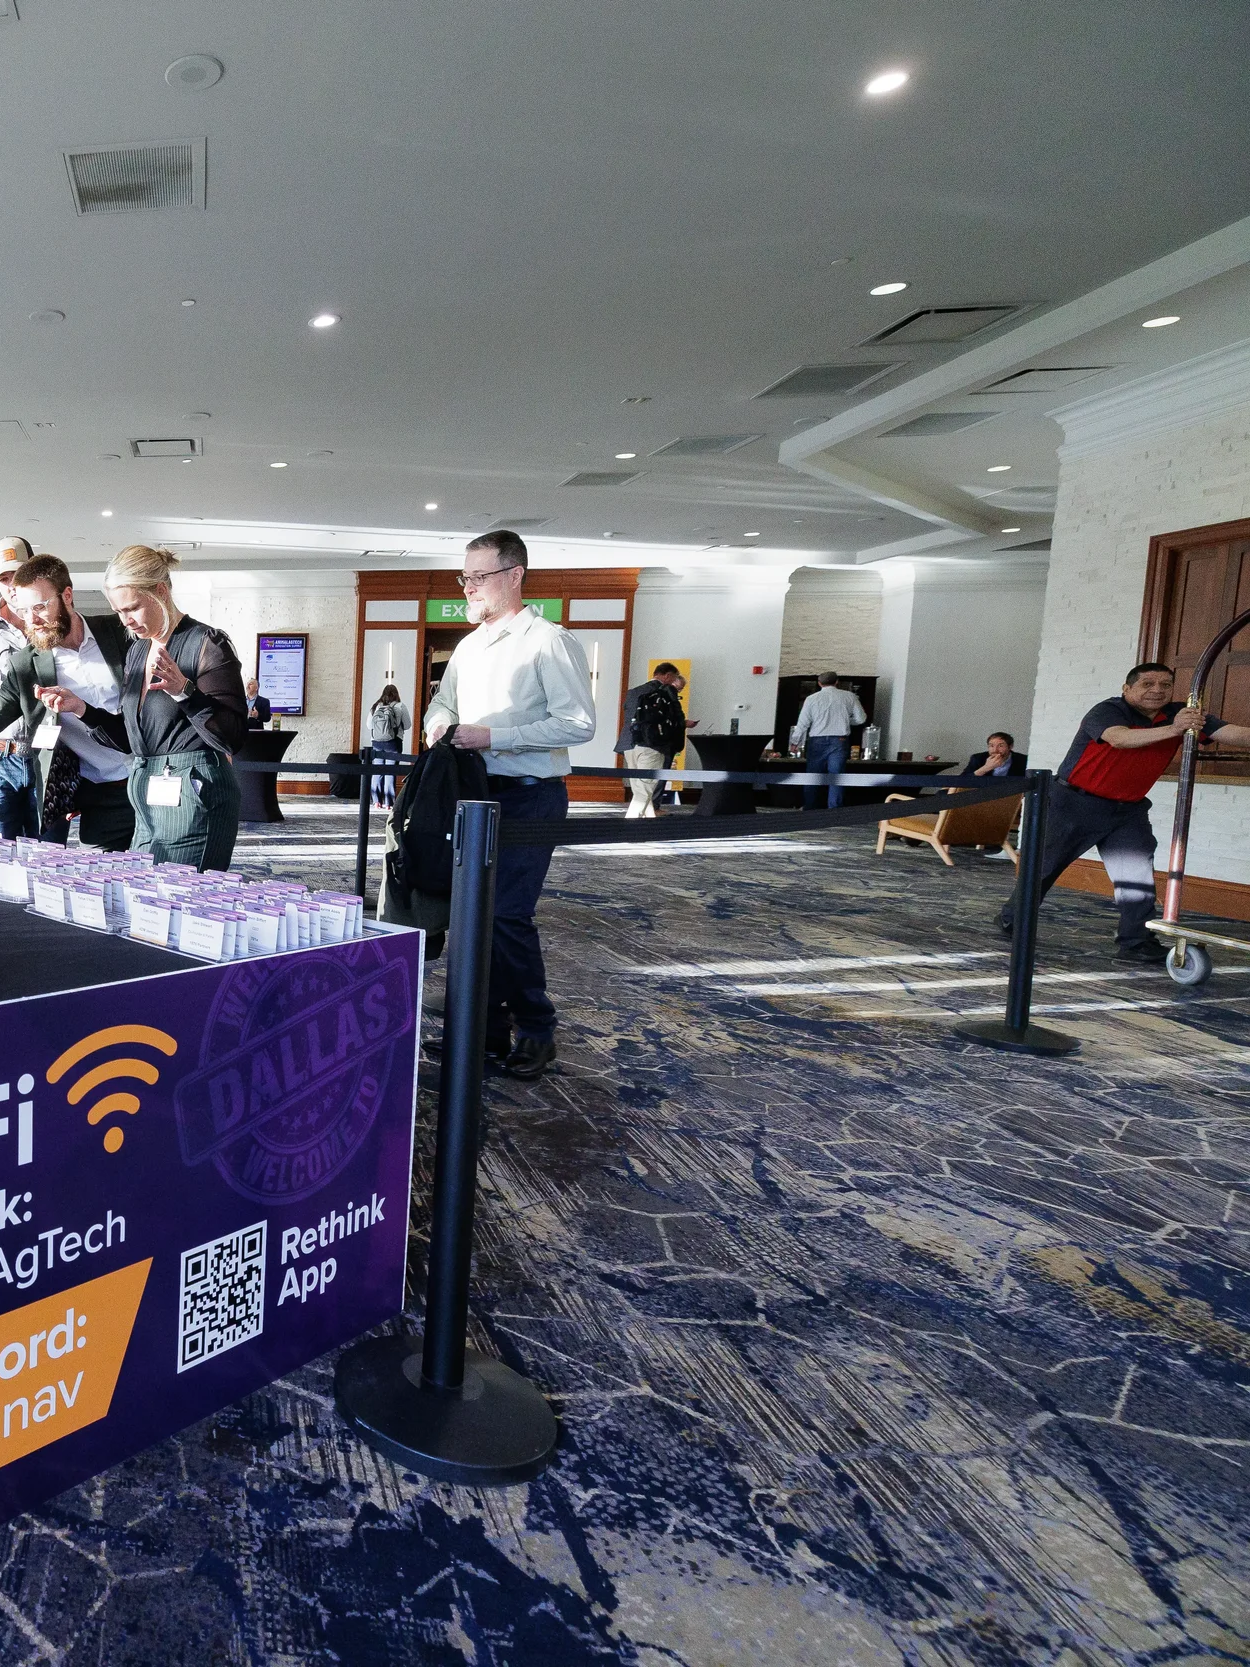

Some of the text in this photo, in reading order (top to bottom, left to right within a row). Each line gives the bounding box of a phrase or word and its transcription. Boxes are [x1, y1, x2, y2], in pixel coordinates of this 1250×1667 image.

[209, 983, 390, 1134] DALLAS
[243, 1075, 379, 1192] WELCOME TO
[280, 1192, 386, 1265] Rethink
[276, 1252, 338, 1306] App
